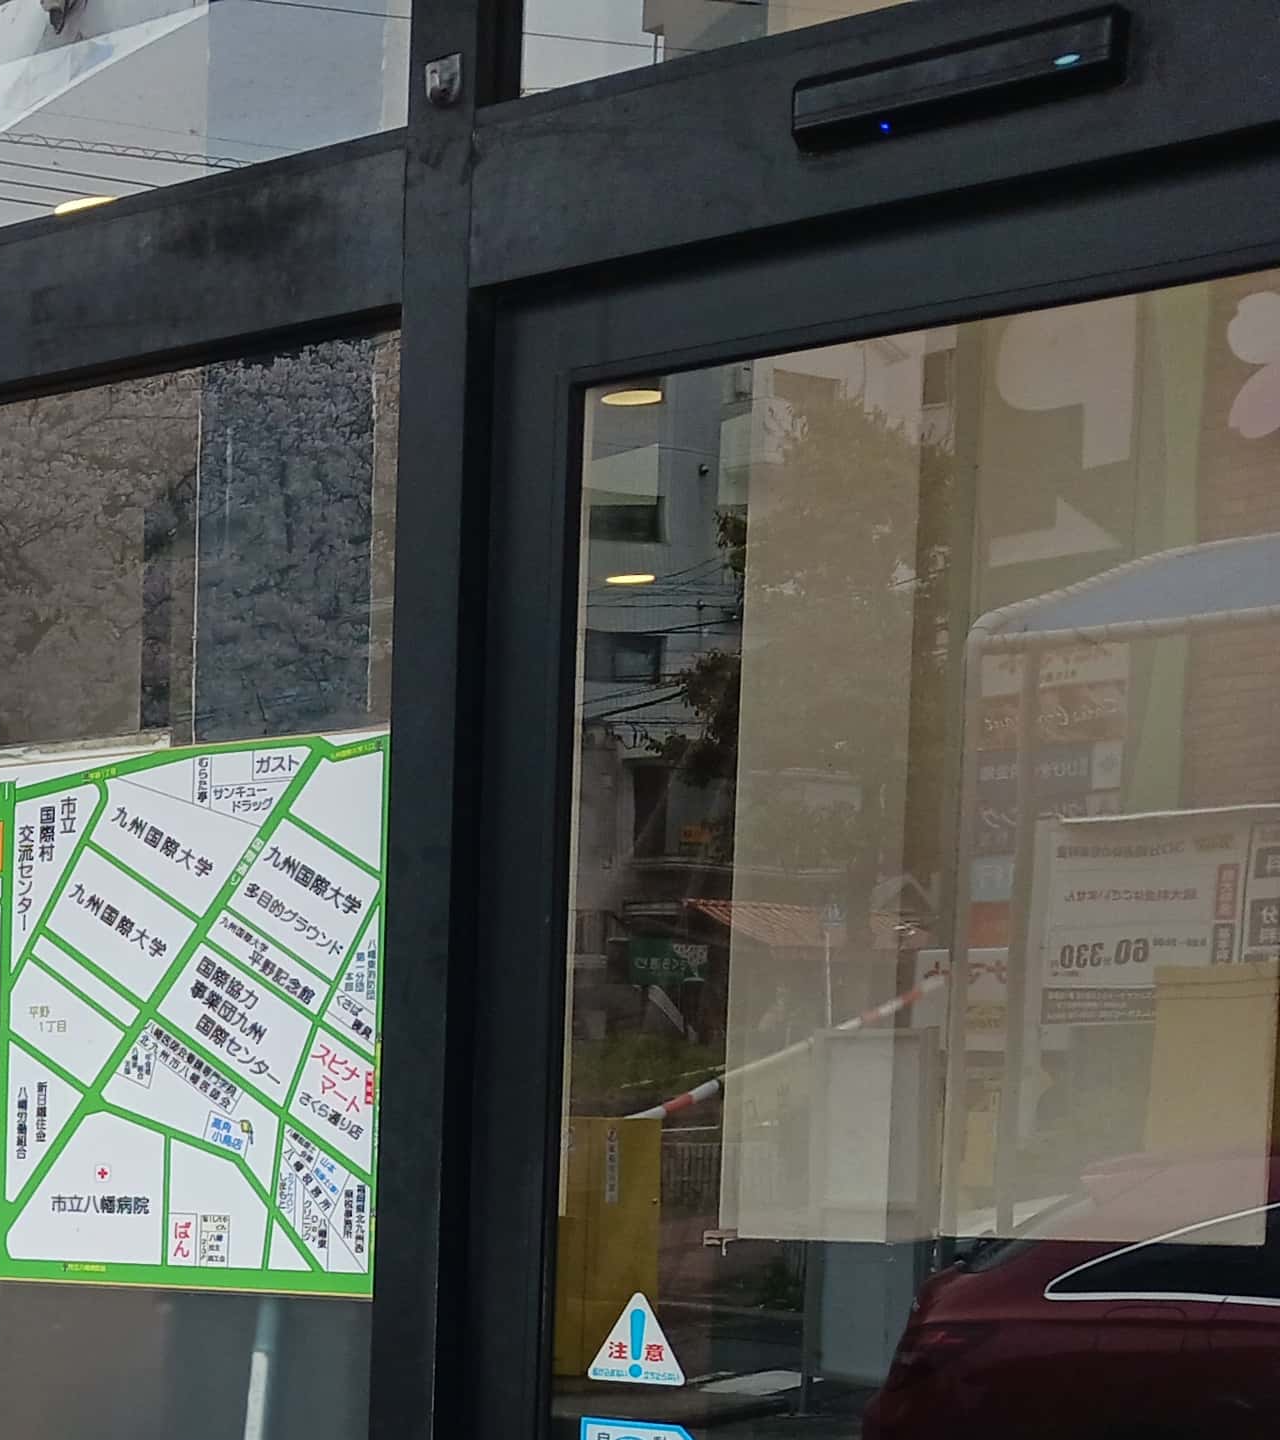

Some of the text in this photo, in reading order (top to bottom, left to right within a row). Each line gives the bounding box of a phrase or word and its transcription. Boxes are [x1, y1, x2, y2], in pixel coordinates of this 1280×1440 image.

[255, 753, 300, 774] ガスト
[59, 796, 77, 834] 市立
[213, 785, 268, 800] サンキュー
[232, 797, 274, 813] ドラッグ
[38, 806, 55, 863] 国際村
[111, 806, 214, 878] 九州国際大学
[17, 825, 35, 931] 交流センター
[263, 845, 363, 915] 九州国際大学
[67, 883, 168, 959] 九州国際大学
[244, 882, 344, 957] 多目的グラウンド
[195, 955, 260, 1010] 国際協力
[248, 950, 316, 1006] 平野記念館
[29, 1006, 50, 1019] 平野
[190, 978, 268, 1046] 事業団九州
[335, 994, 363, 1017] くさば
[195, 1013, 281, 1085] 国際センター
[311, 1043, 360, 1081] スピナ
[298, 1091, 364, 1141] さくら通り店
[320, 1074, 360, 1113] マート
[51, 1194, 150, 1215] 市立八幡病院
